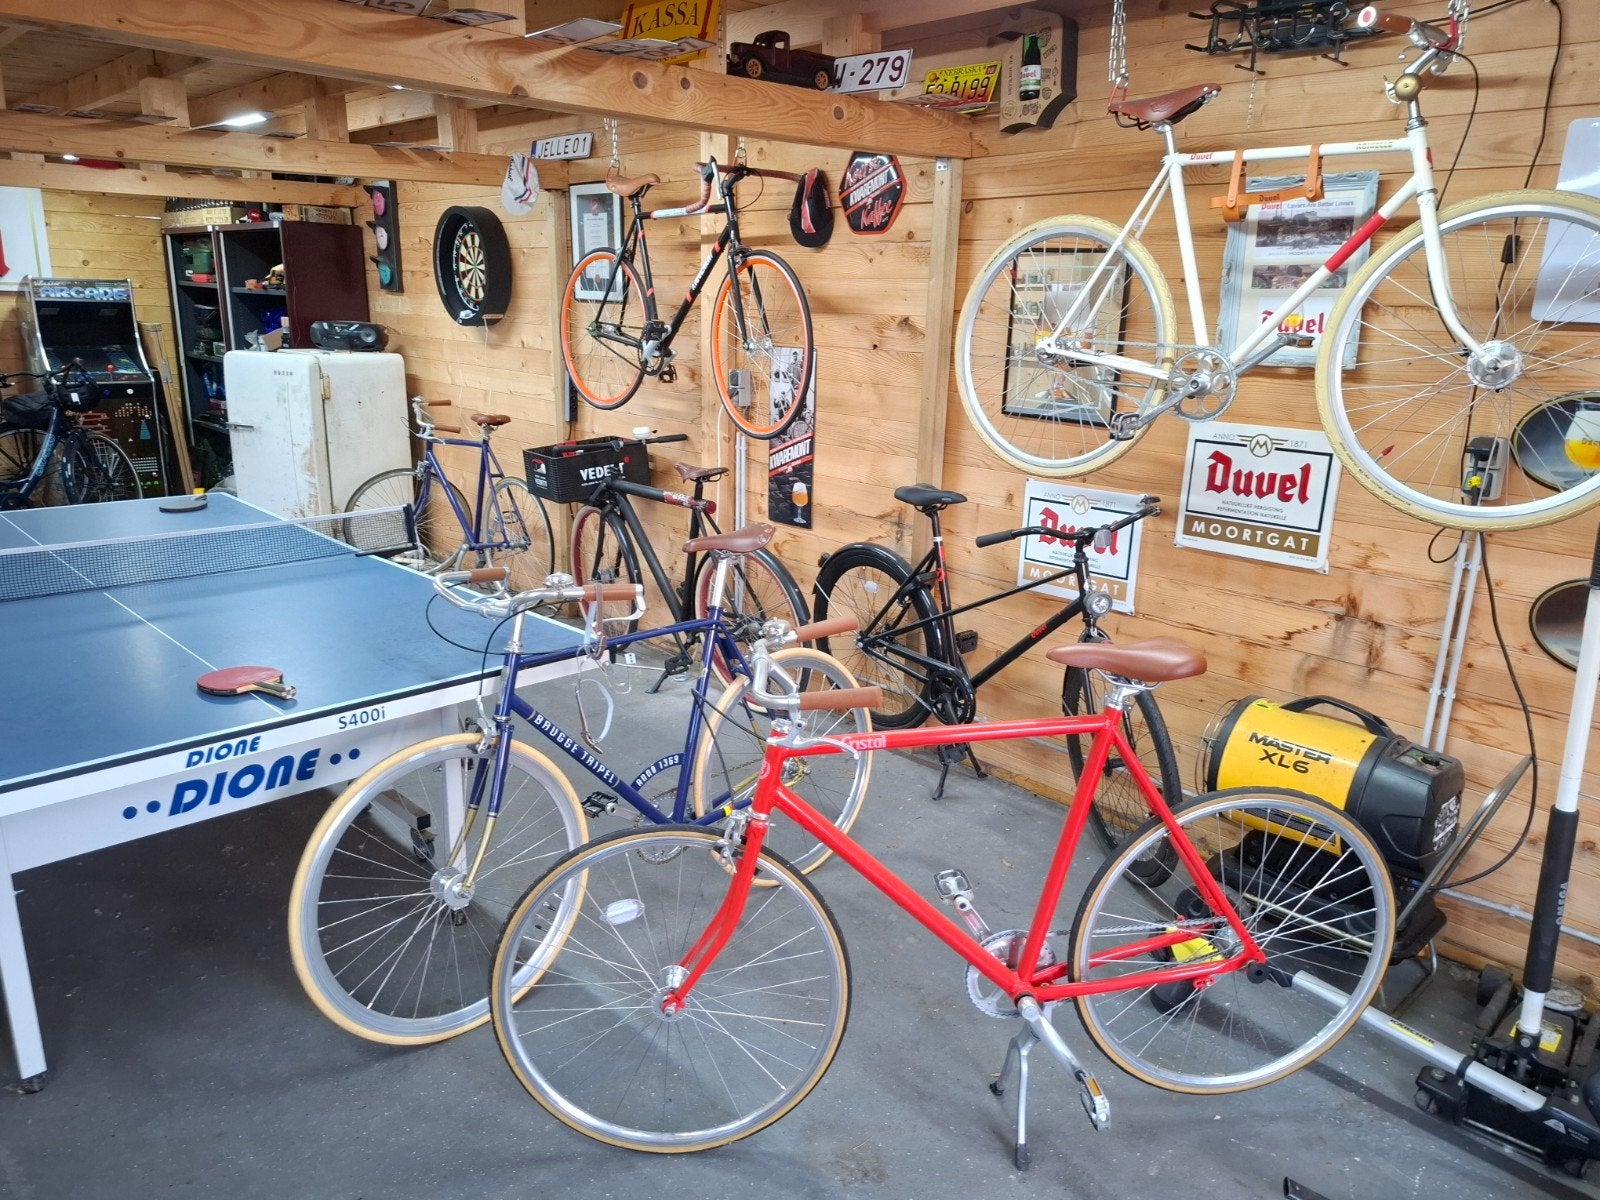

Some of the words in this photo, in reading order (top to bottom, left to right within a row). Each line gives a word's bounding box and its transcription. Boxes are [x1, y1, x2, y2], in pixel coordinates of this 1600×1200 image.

[632, 2, 699, 38] KASSA
[943, 65, 982, 77] NEBRASKA
[1190, 152, 1213, 161] Duvel
[850, 170, 888, 206] KWAREMONT
[1259, 193, 1280, 202] Duvel
[1261, 202, 1283, 210] Duvel
[40, 286, 128, 300] ARCADE
[769, 439, 812, 471] KWAREMONT
[1212, 433, 1236, 441] ANNO
[1290, 440, 1308, 448] 1871
[580, 462, 625, 481] VEDET
[1205, 450, 1312, 504] Duvel
[1191, 520, 1310, 551] MOORTGAT
[337, 706, 386, 730] S400i
[185, 735, 261, 769] DIONE
[534, 714, 577, 754] BRUGGE
[580, 750, 617, 784] TRIPEL
[1248, 731, 1333, 765] MASTER
[1259, 748, 1310, 774] XL6
[168, 747, 321, 817] DIONE
[635, 766, 657, 787] ANNO
[659, 755, 680, 770] 1369
